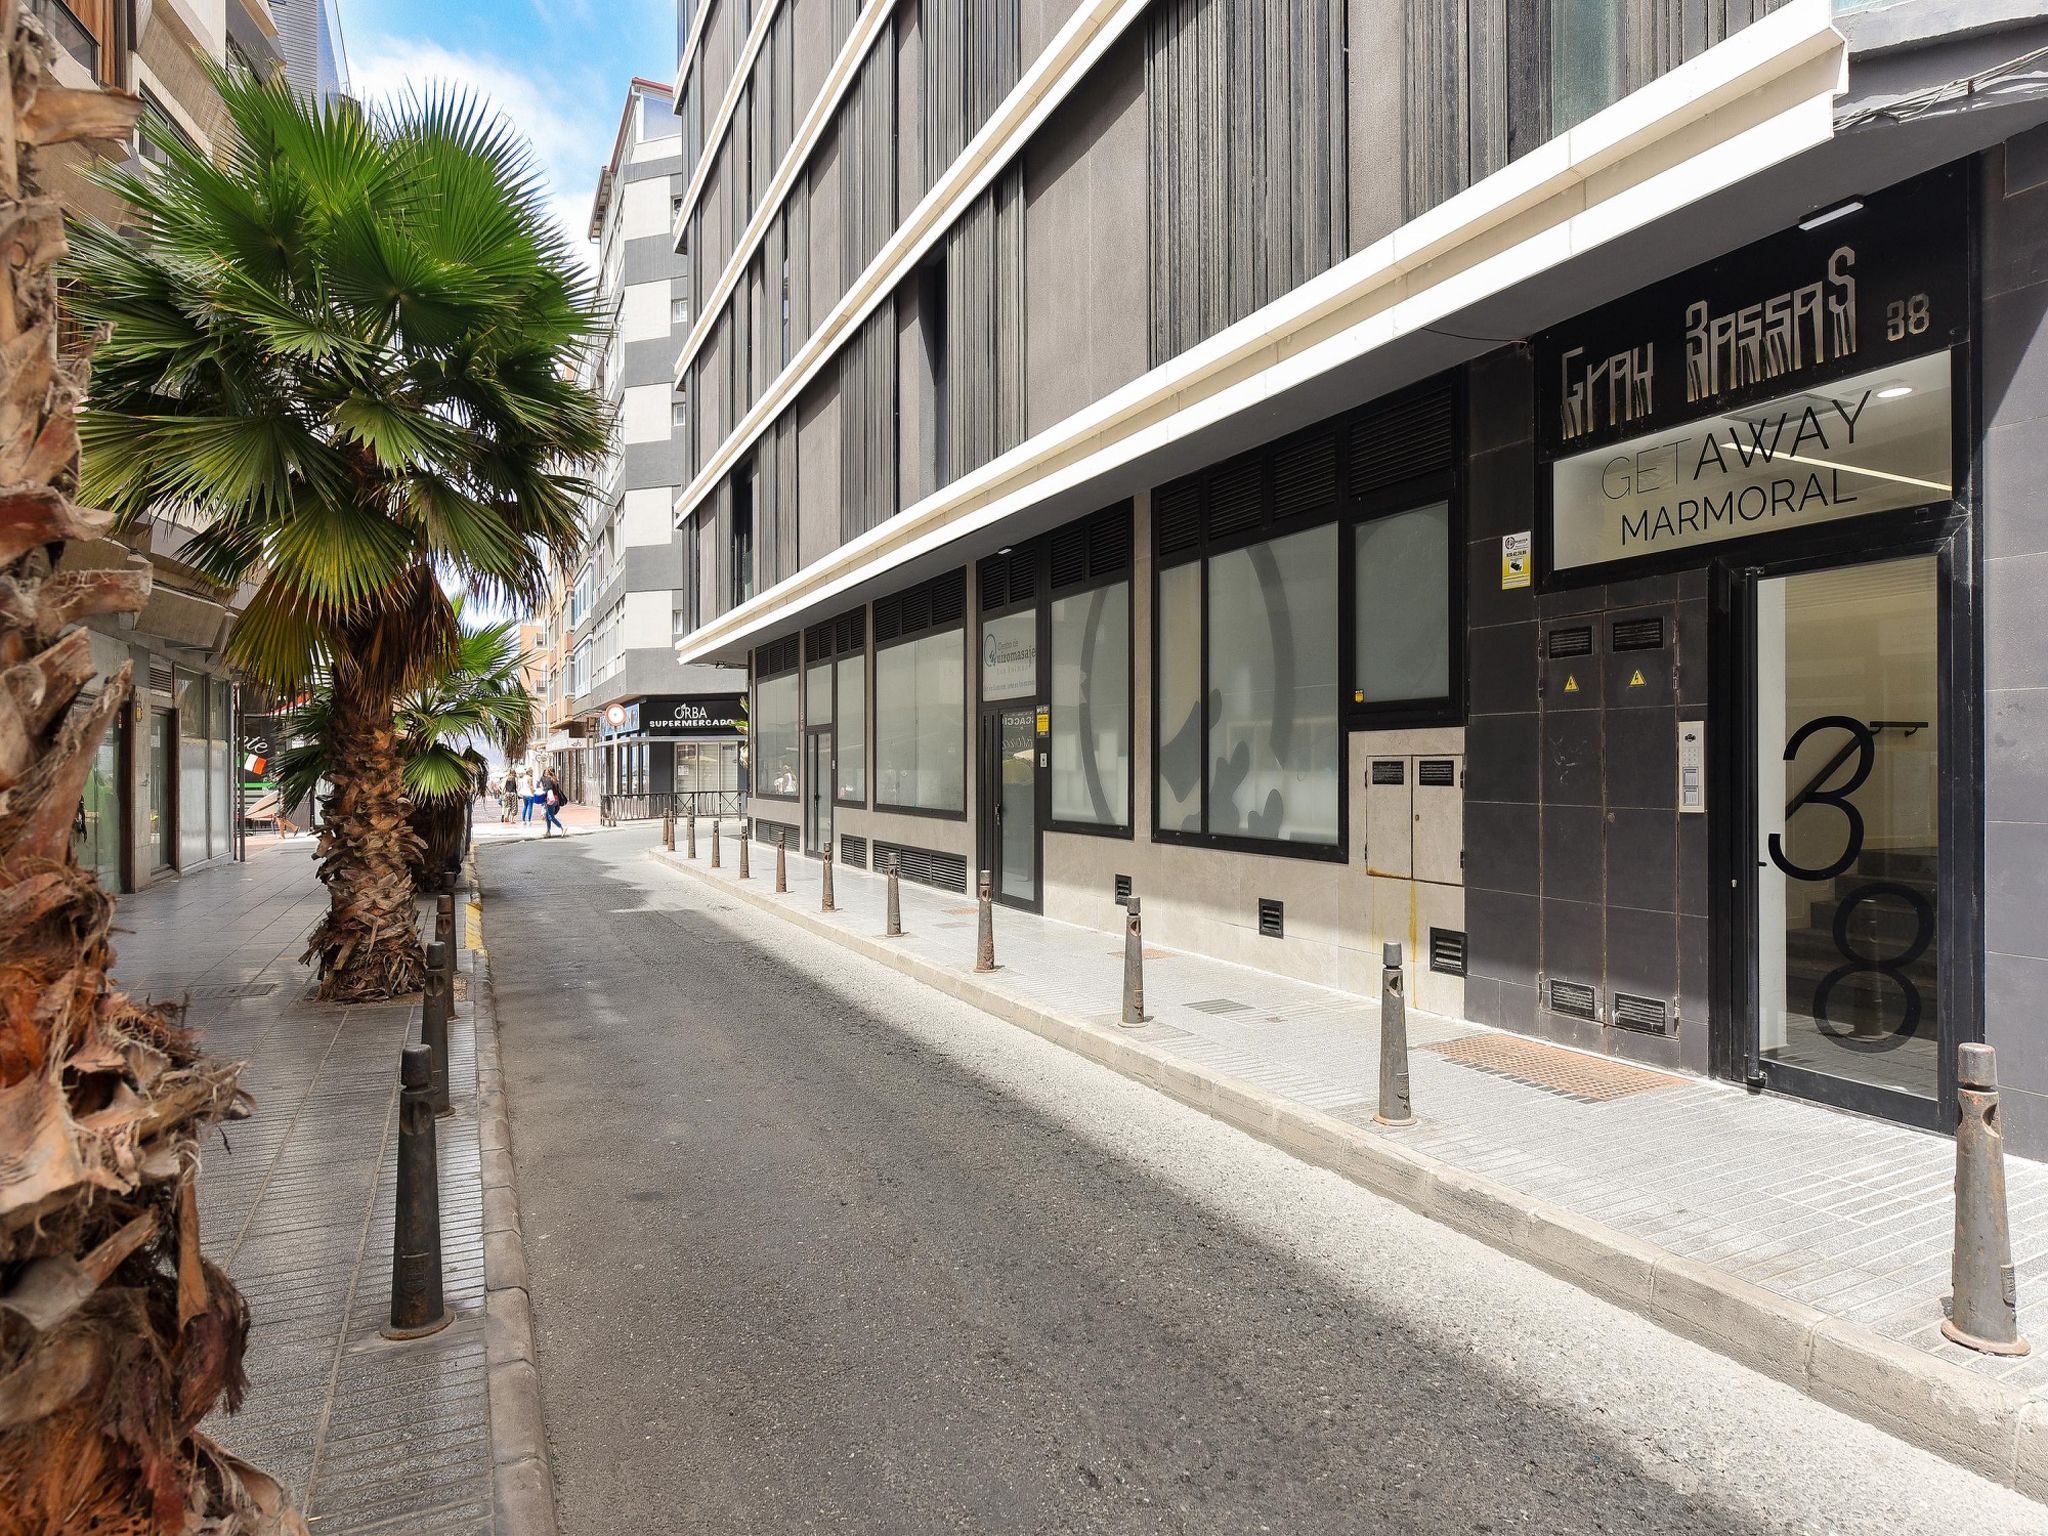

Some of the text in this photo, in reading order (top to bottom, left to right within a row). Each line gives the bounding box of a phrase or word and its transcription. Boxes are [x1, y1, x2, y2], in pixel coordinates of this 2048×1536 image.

[1886, 293, 1930, 342] 38
[1601, 391, 1872, 501] GETAWAY
[1621, 470, 1857, 546] MARMORAL
[649, 719, 735, 727] SUPERMERCADO
[674, 703, 707, 719] ORBA
